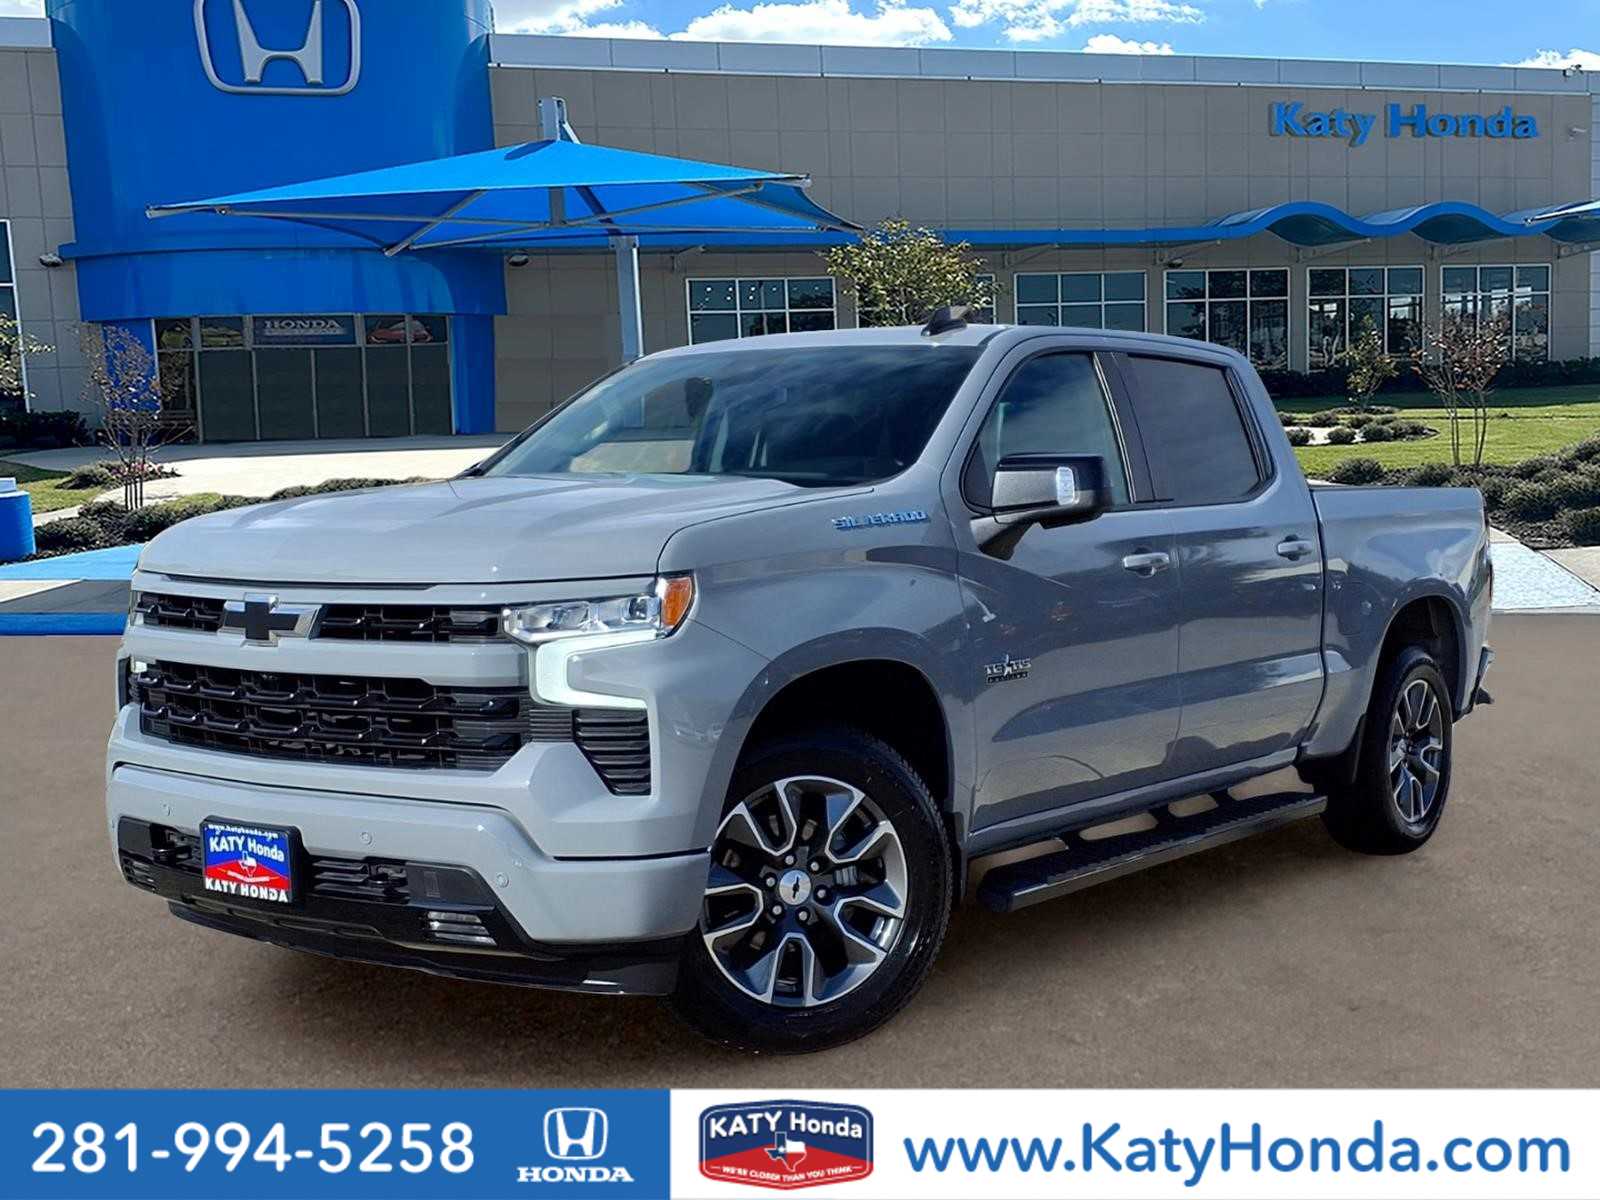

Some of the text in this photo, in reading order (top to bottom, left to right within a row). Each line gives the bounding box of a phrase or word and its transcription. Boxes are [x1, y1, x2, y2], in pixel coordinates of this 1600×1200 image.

[1269, 101, 1539, 147] Katy Honda
[264, 319, 342, 329] HONDA
[209, 836, 285, 862] KATY Honda
[205, 877, 289, 903] KATY HONDA
